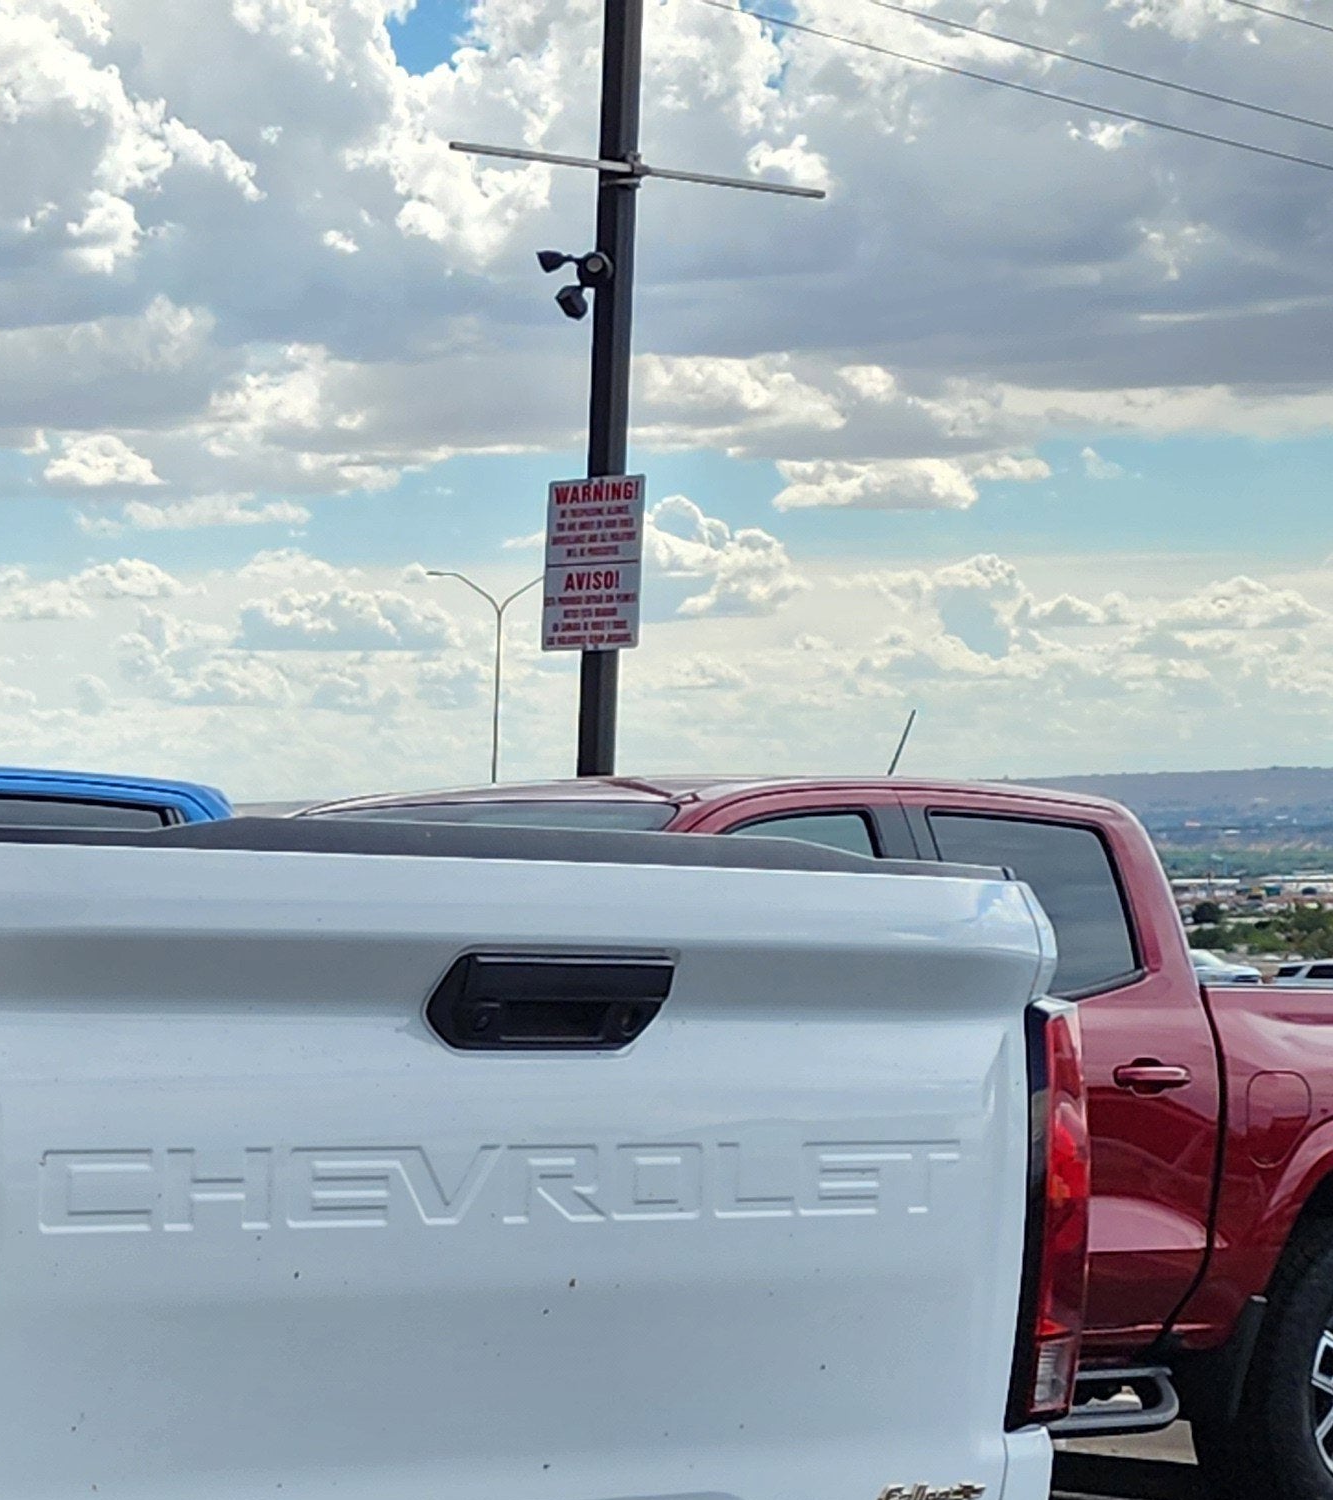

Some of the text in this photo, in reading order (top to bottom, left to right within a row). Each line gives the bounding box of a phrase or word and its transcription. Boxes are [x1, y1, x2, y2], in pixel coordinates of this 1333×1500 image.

[554, 481, 639, 505] WARNING!
[564, 570, 620, 592] AVISO!
[39, 1141, 961, 1233] CHEVROLET
